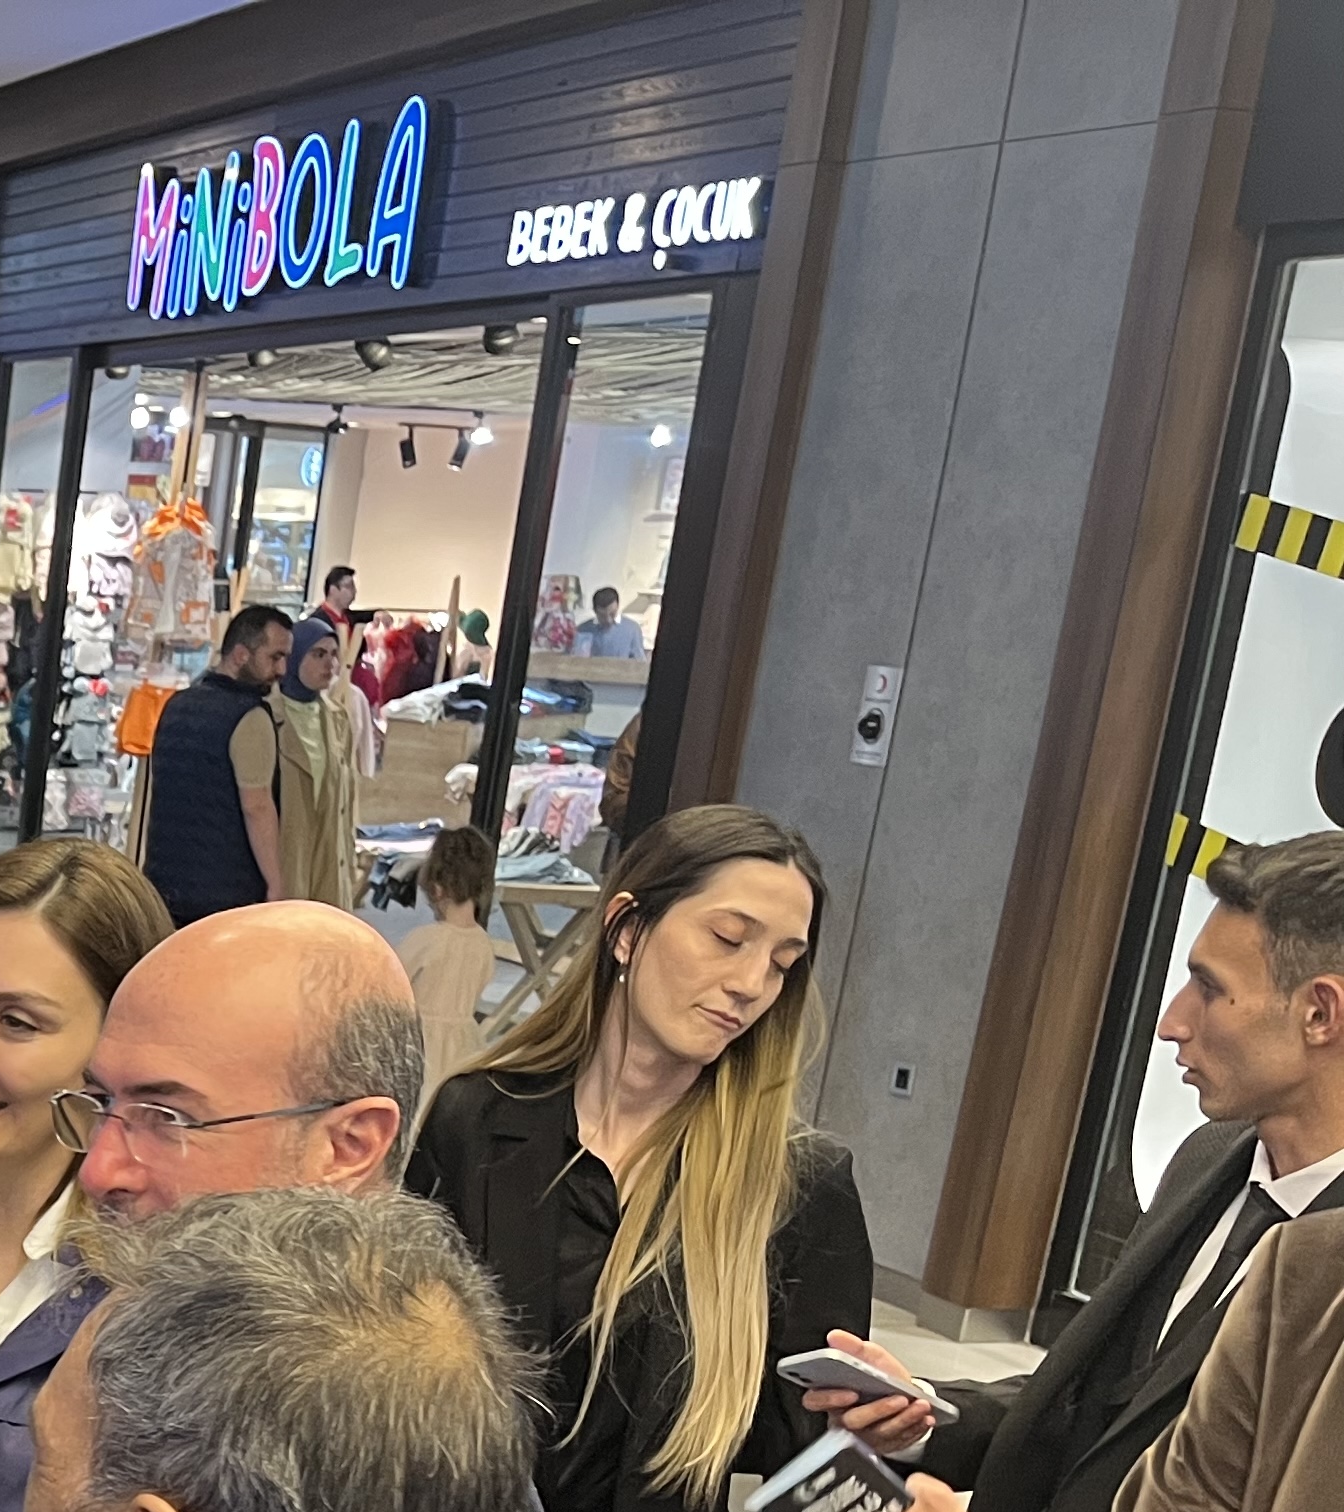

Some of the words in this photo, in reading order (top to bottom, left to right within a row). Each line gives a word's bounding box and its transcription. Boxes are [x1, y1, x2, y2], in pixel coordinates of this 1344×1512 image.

[506, 197, 616, 268] BEBEK
[616, 192, 648, 253] &
[650, 175, 763, 272] ÇOCUK
